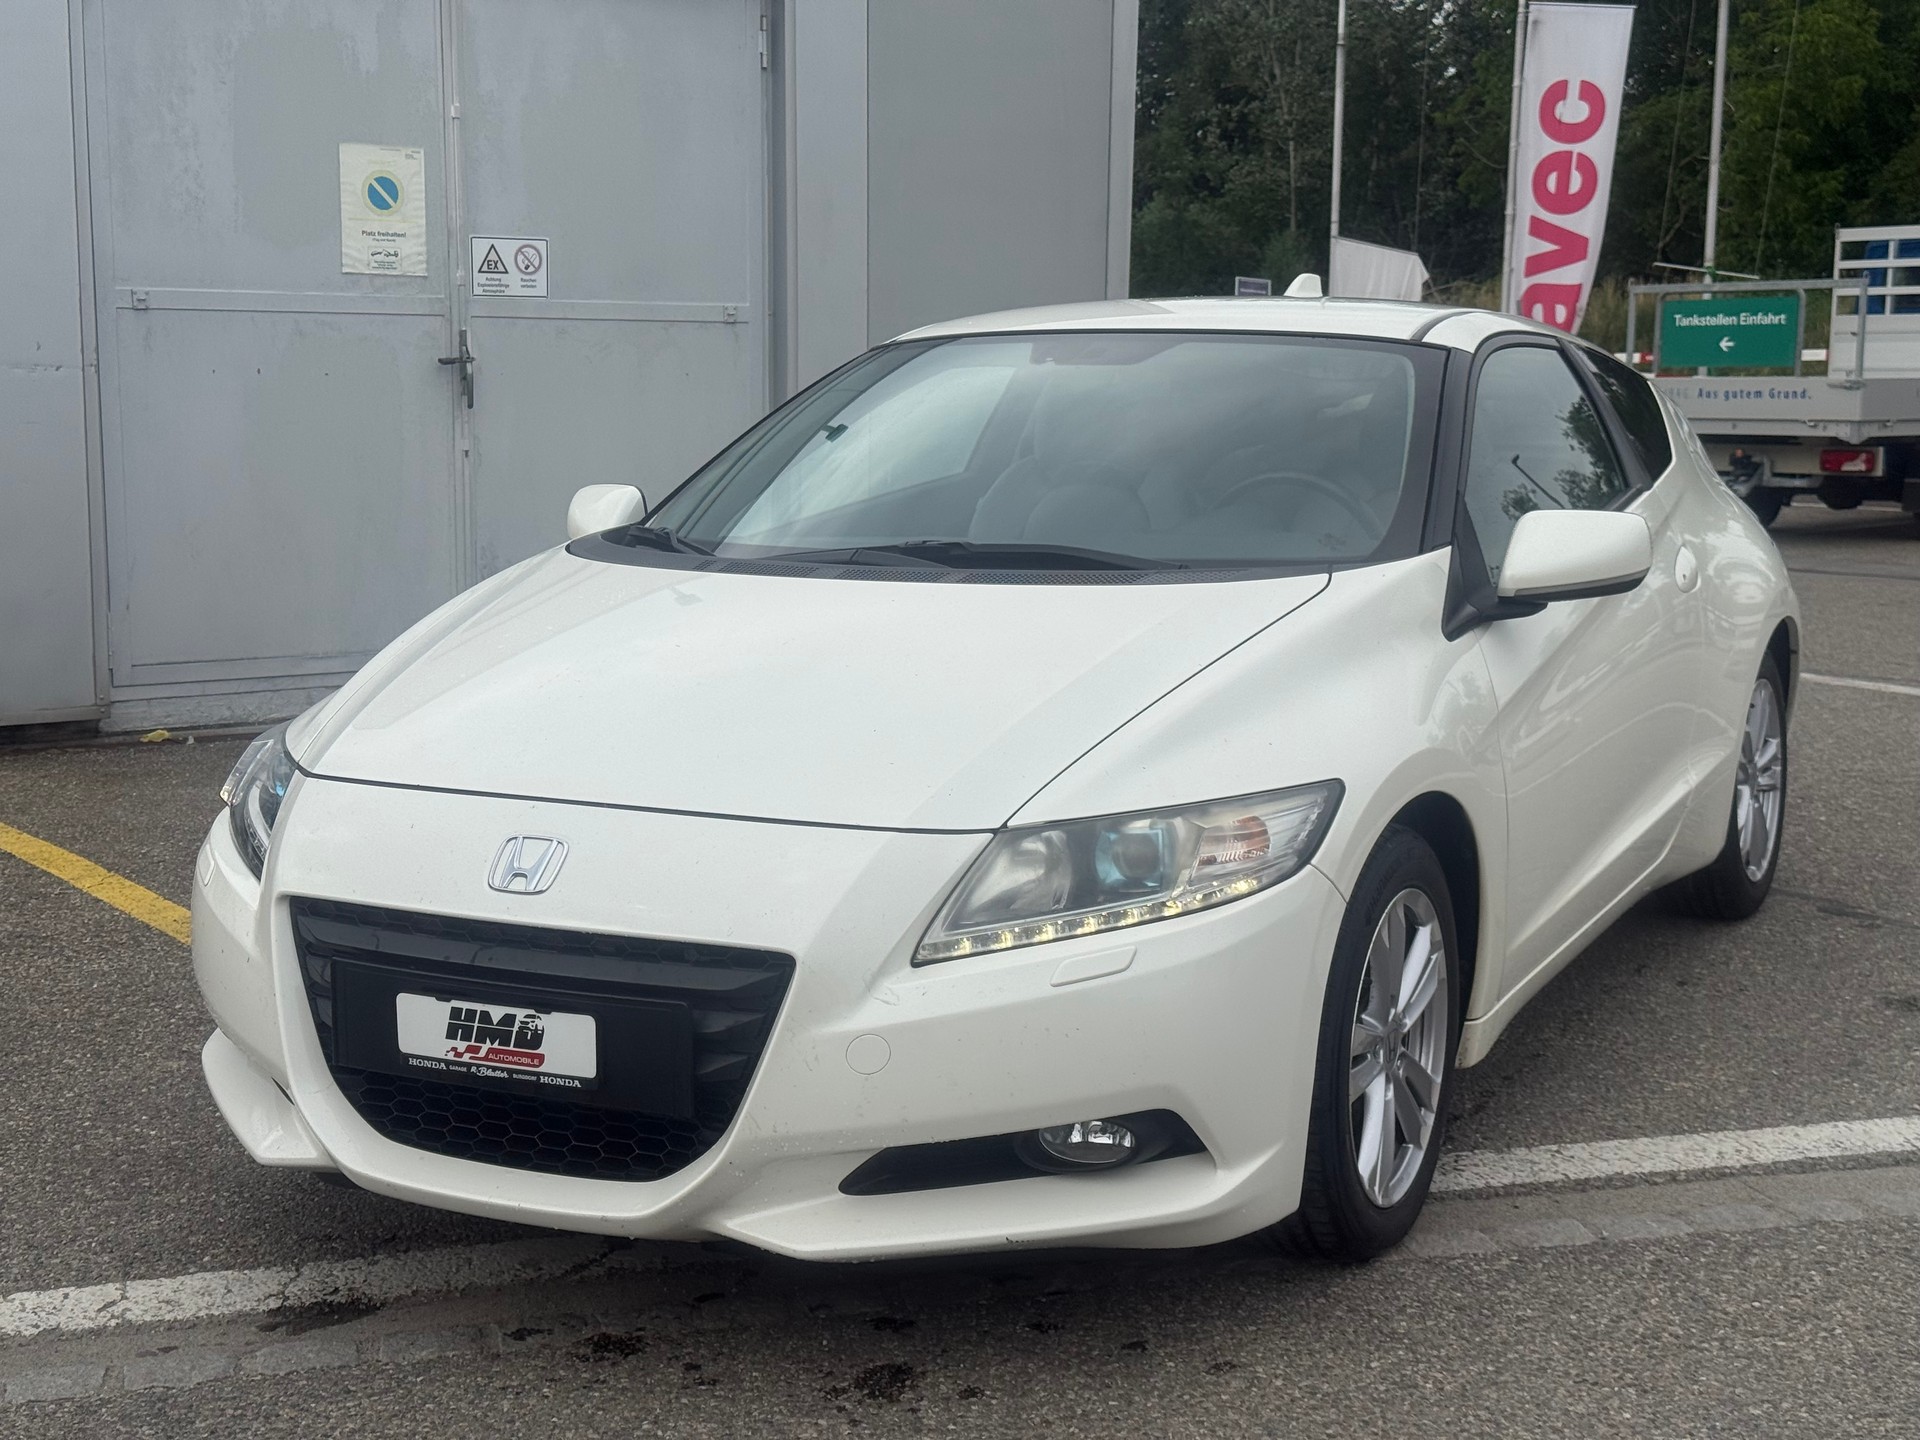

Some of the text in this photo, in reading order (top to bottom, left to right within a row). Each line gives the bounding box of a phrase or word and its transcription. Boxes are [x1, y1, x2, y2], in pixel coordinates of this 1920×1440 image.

[1520, 79, 1606, 334] avec
[486, 259, 499, 270] EX
[1673, 312, 1787, 327] Tankstellen Einfahrt
[1697, 388, 1719, 399] Aus
[1723, 389, 1763, 401] gutem
[1768, 387, 1812, 400] Grund.
[488, 1053, 540, 1066] AUTOMOBILE
[408, 1057, 447, 1071] HONDA
[539, 1075, 582, 1088] HONDA
